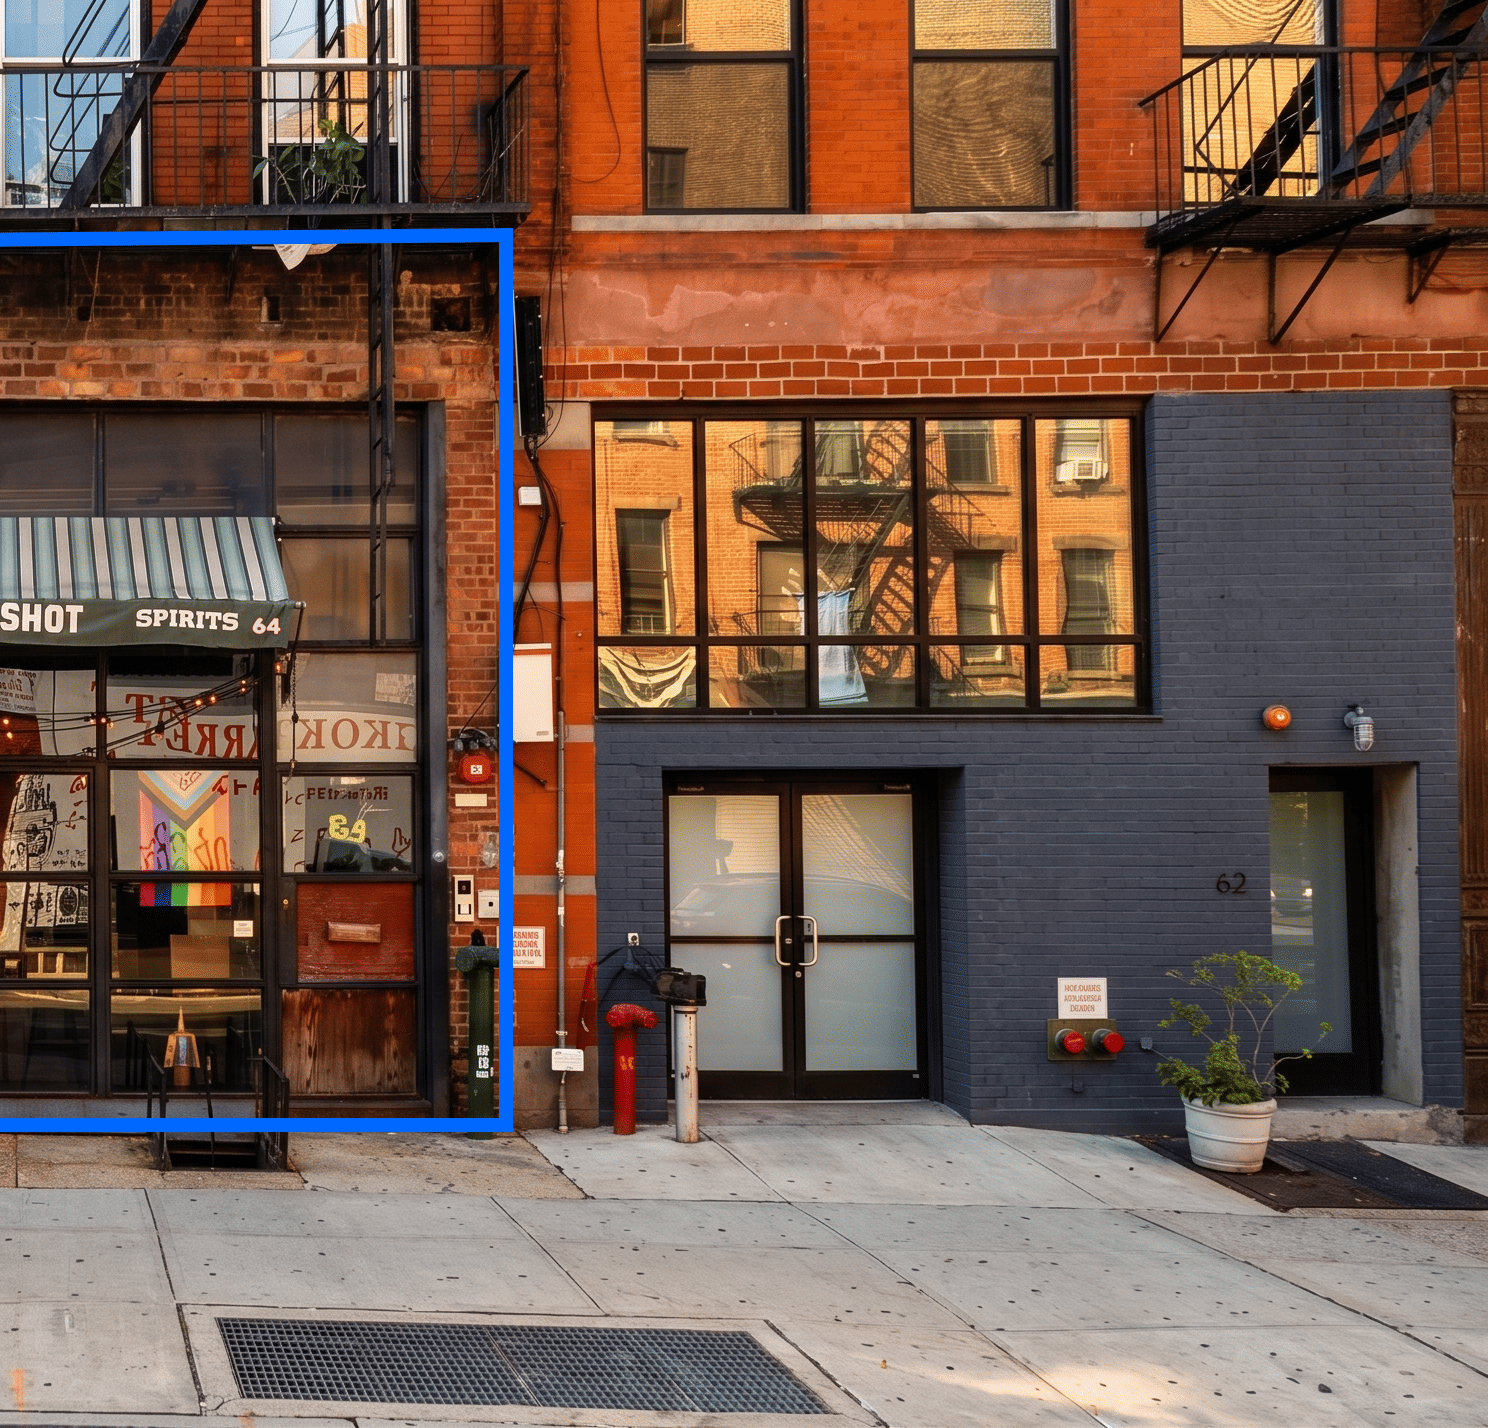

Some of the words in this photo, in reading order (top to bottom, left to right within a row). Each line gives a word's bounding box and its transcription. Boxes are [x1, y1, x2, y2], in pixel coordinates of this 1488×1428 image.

[135, 608, 239, 631] SPIRITS
[252, 617, 281, 635] 64
[1216, 872, 1247, 894] 62
